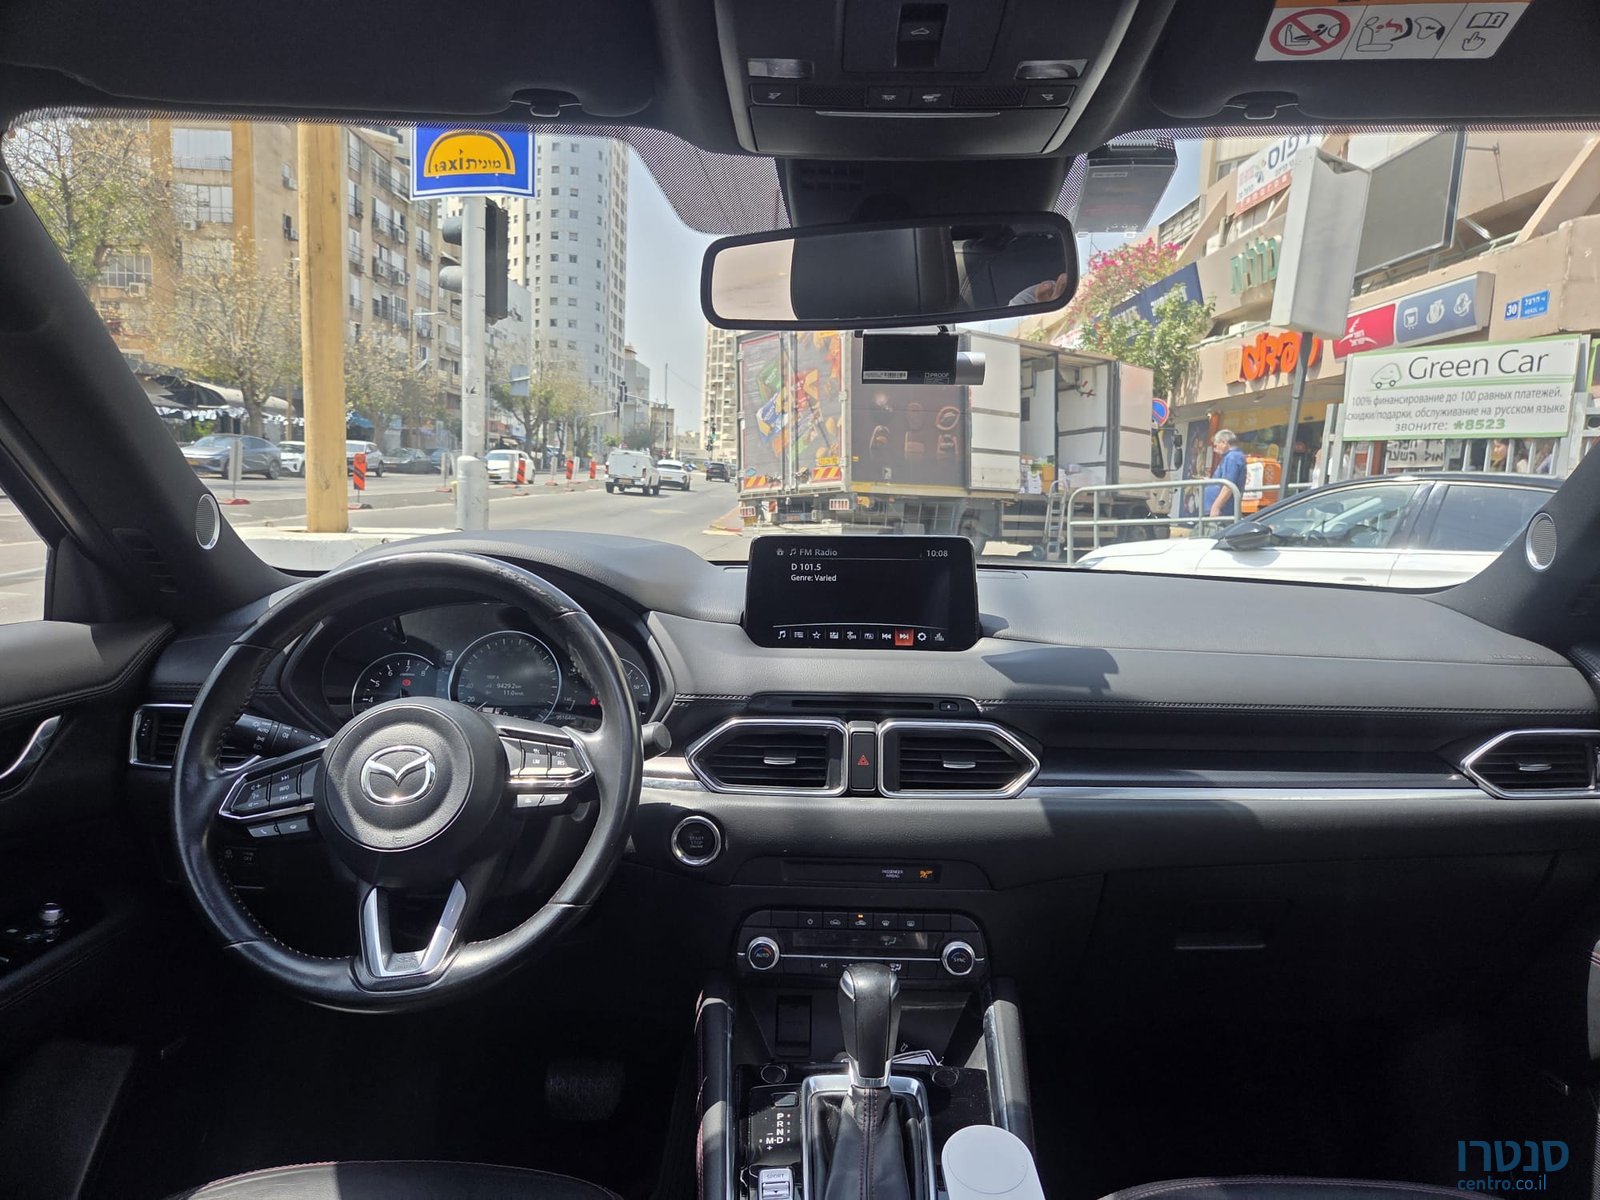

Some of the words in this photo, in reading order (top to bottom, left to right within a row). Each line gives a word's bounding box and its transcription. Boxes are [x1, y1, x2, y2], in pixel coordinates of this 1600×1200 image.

[434, 153, 464, 172] taxi
[465, 158, 501, 170] מונית
[1506, 303, 1518, 317] 30
[1408, 356, 1489, 380] Green
[1498, 349, 1549, 374] Car
[1352, 397, 1372, 406] 100%
[1373, 393, 1445, 408] финансирование
[1445, 393, 1457, 403] до
[1461, 391, 1476, 402] 100
[1477, 391, 1512, 403] равных
[1513, 386, 1562, 400] платежей.
[1415, 405, 1479, 419] обслуживание
[1481, 407, 1492, 416] на
[1494, 404, 1534, 417] русском
[1535, 403, 1568, 414] языке.
[1395, 421, 1448, 433] звоните:
[1424, 451, 1444, 462] מול
[799, 548, 812, 556] FM
[815, 548, 838, 557] Radio
[926, 549, 949, 557] 10:08
[791, 563, 798, 571] D
[800, 563, 822, 571] 101.5
[791, 574, 814, 583] Genre:
[814, 574, 837, 582] Varied
[776, 1112, 784, 1120] P
[776, 1128, 784, 1136] N
